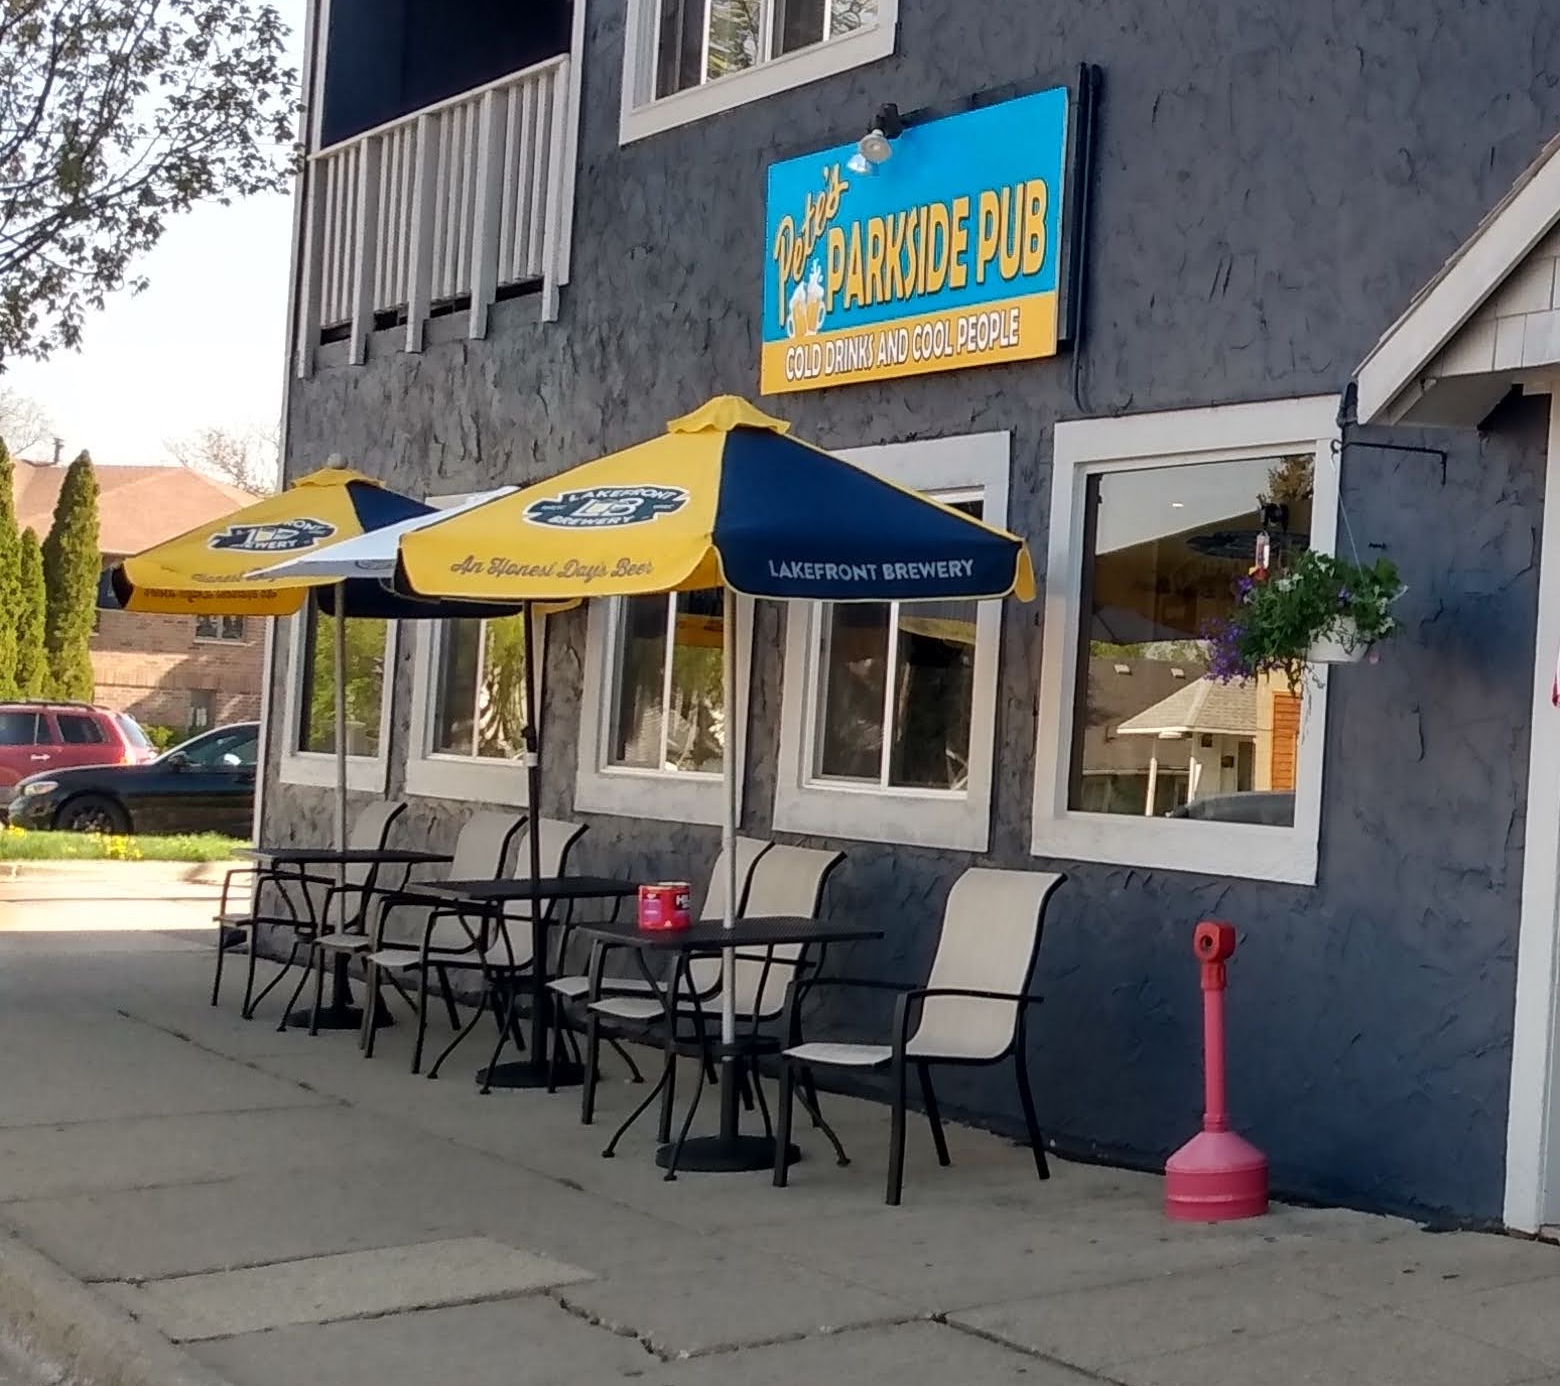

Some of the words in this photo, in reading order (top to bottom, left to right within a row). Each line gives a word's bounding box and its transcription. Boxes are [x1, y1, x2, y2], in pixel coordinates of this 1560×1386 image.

[774, 163, 849, 327] Pete's
[825, 195, 970, 312] PARKSIDE
[976, 179, 1048, 284] PUB
[786, 345, 822, 381] COLD
[825, 331, 874, 375] DRINKS
[876, 326, 909, 366] AND
[912, 318, 953, 360] COOL
[956, 308, 1020, 354] PEOPLE
[568, 488, 676, 502] LAKEFRONT
[547, 515, 634, 525] BREWERY
[450, 555, 484, 575] An
[486, 557, 556, 578] Honest
[610, 557, 653, 578] Beer
[768, 559, 878, 581] LAKEFRONT
[882, 559, 974, 581] BREWERY
